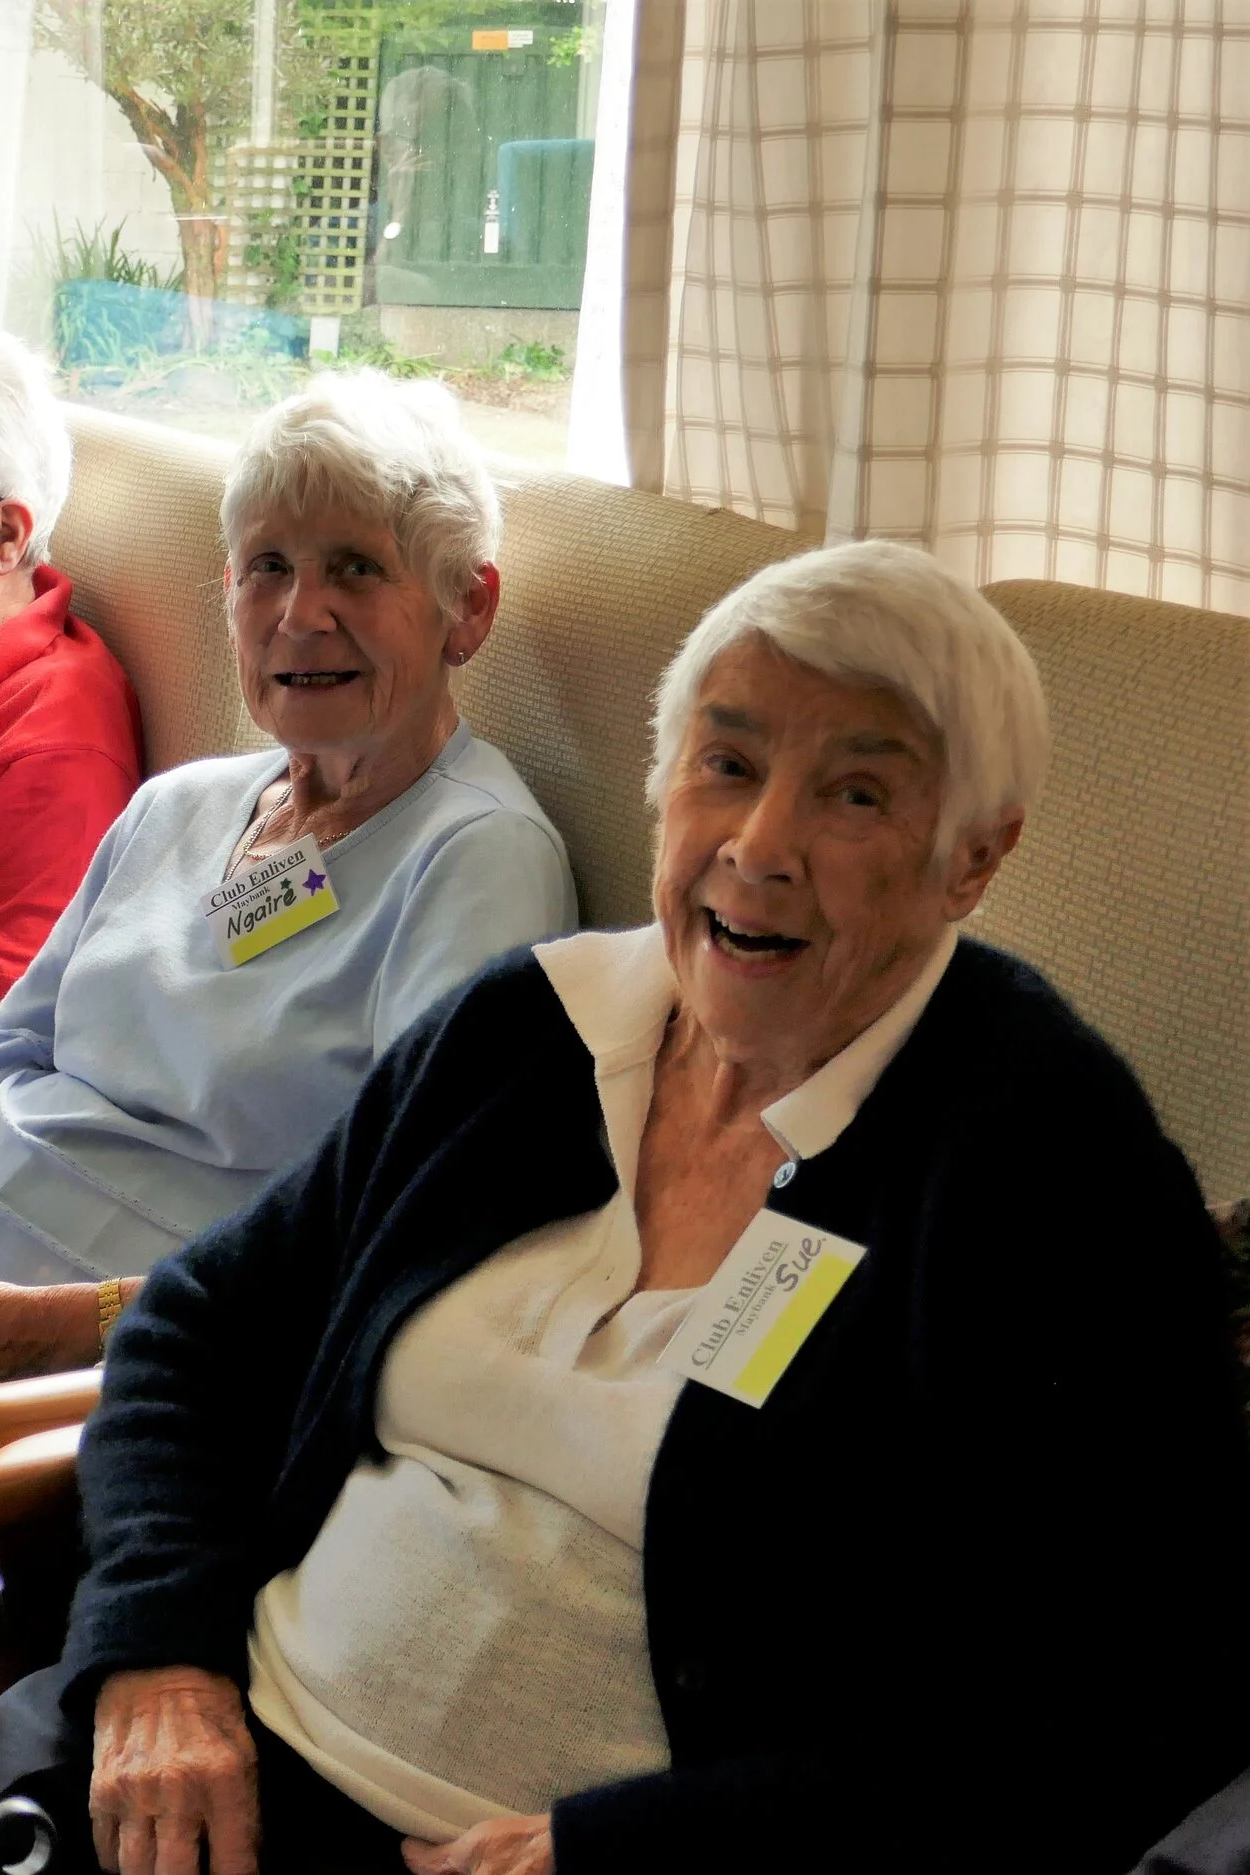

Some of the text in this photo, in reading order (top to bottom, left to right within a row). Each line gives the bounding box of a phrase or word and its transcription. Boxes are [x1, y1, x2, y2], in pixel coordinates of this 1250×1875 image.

[210, 850, 305, 908] Club Enliven
[231, 885, 271, 911] Maybank
[227, 888, 297, 939] Ngaire
[691, 1240, 784, 1367] Club Enliven
[736, 1284, 779, 1337] Maybank
